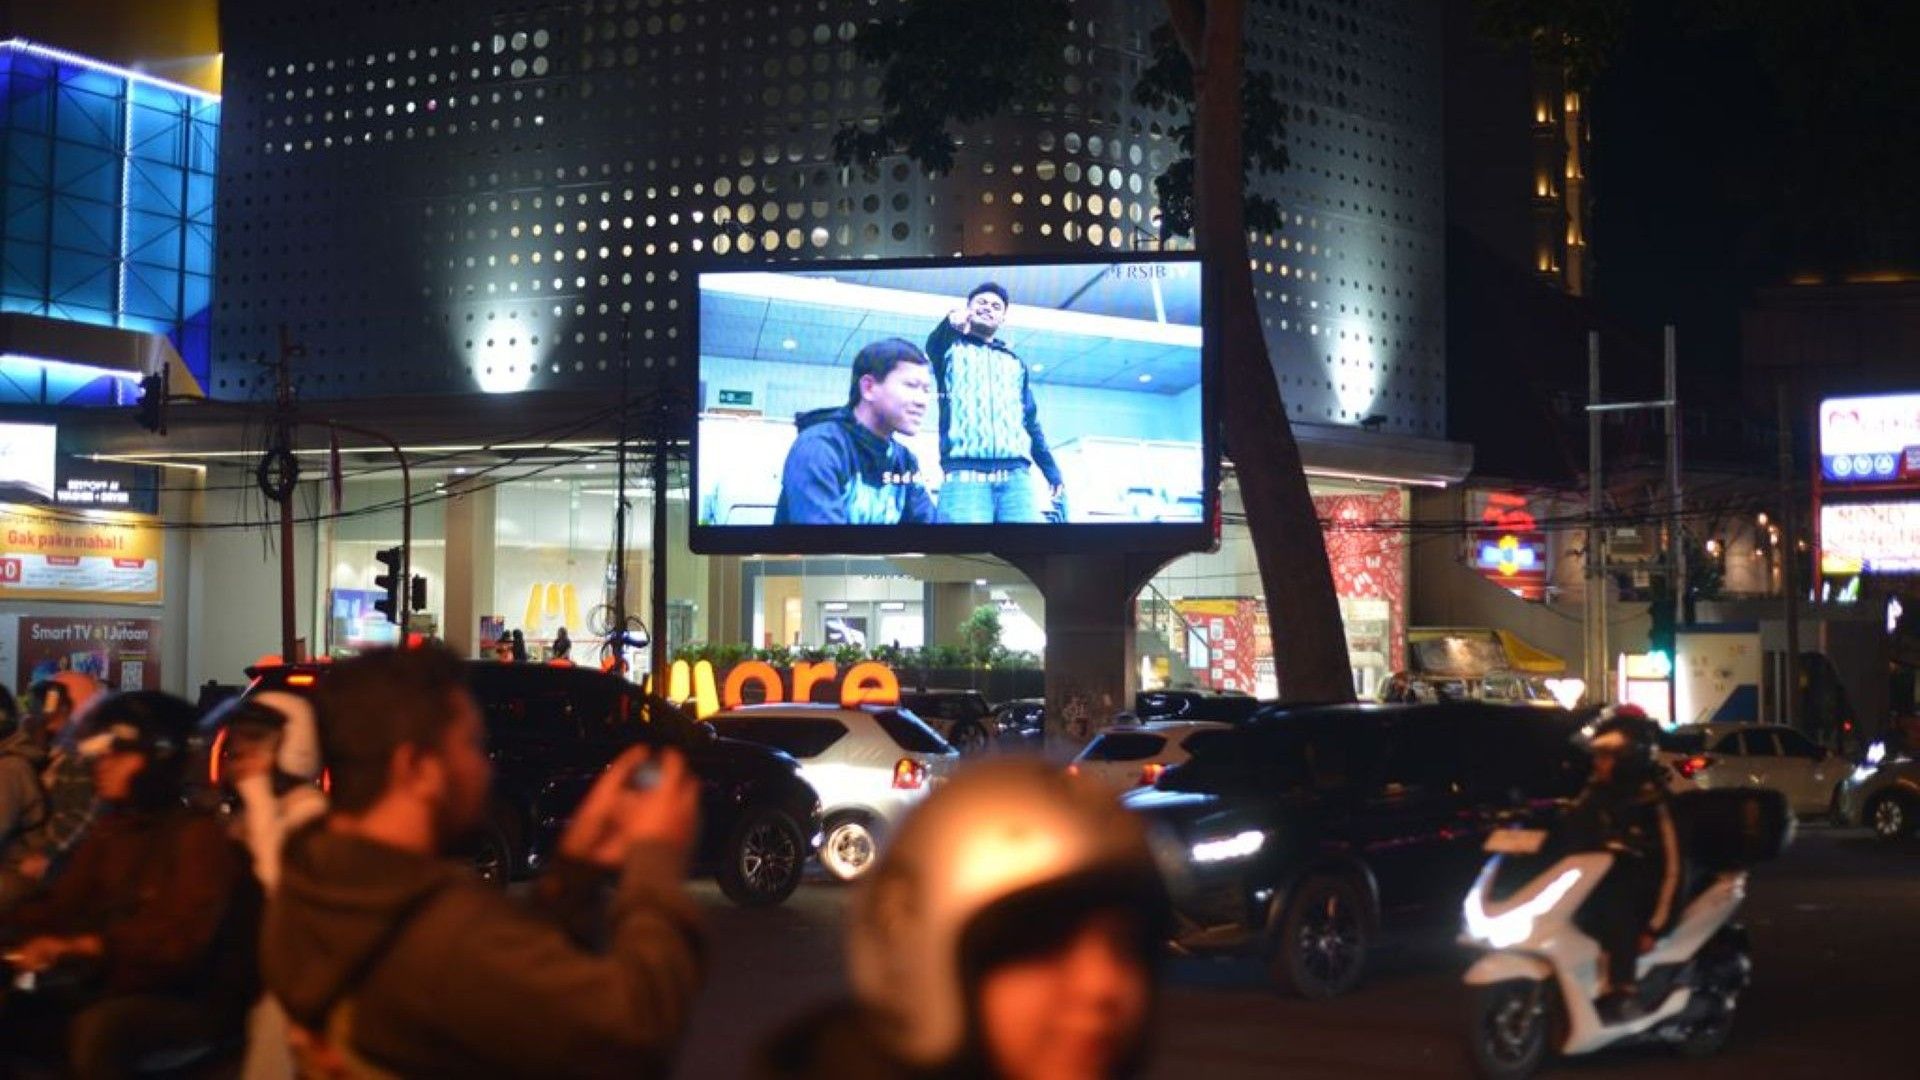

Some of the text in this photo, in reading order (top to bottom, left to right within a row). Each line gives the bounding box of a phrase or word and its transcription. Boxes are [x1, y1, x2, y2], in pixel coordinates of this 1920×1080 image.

[8, 529, 35, 545] Gak
[32, 623, 72, 640] Smart
[74, 624, 92, 640] TV
